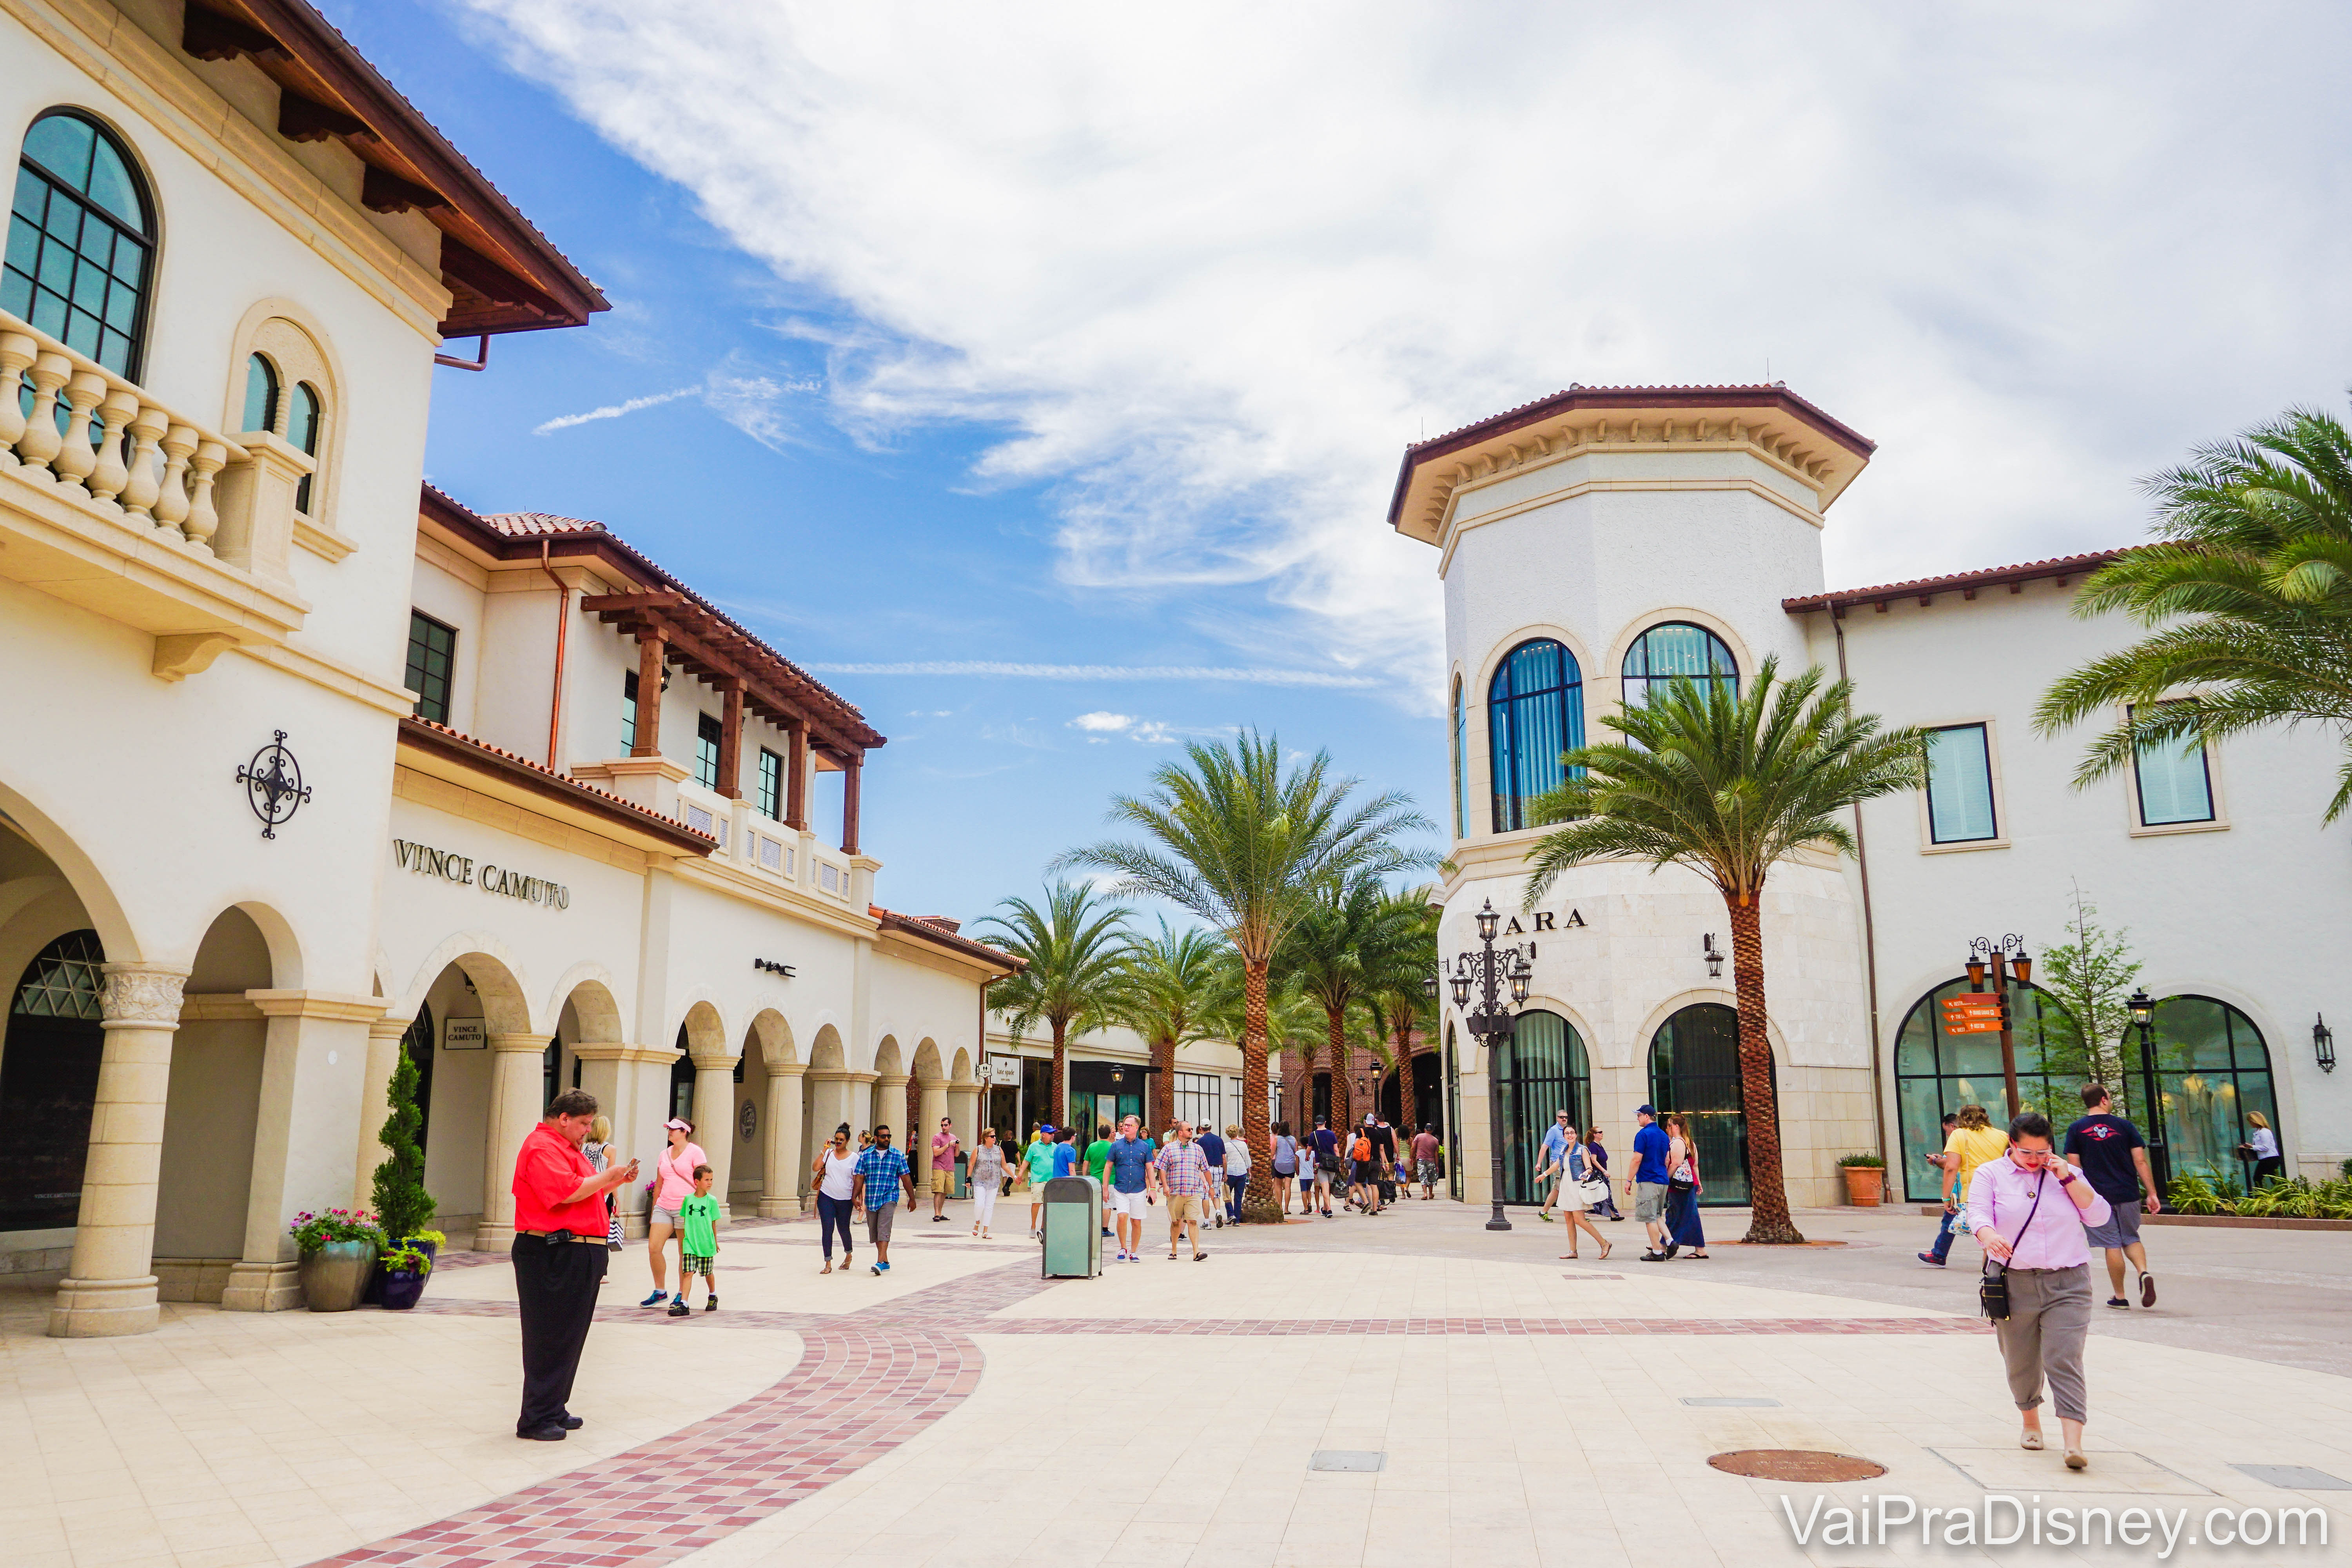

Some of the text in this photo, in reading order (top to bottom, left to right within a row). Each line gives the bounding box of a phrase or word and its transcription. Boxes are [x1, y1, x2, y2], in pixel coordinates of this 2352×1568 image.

[393, 838, 570, 910] VINCE CAMUTO
[1503, 908, 1588, 935] ARA
[1005, 1069, 1014, 1077] spade
